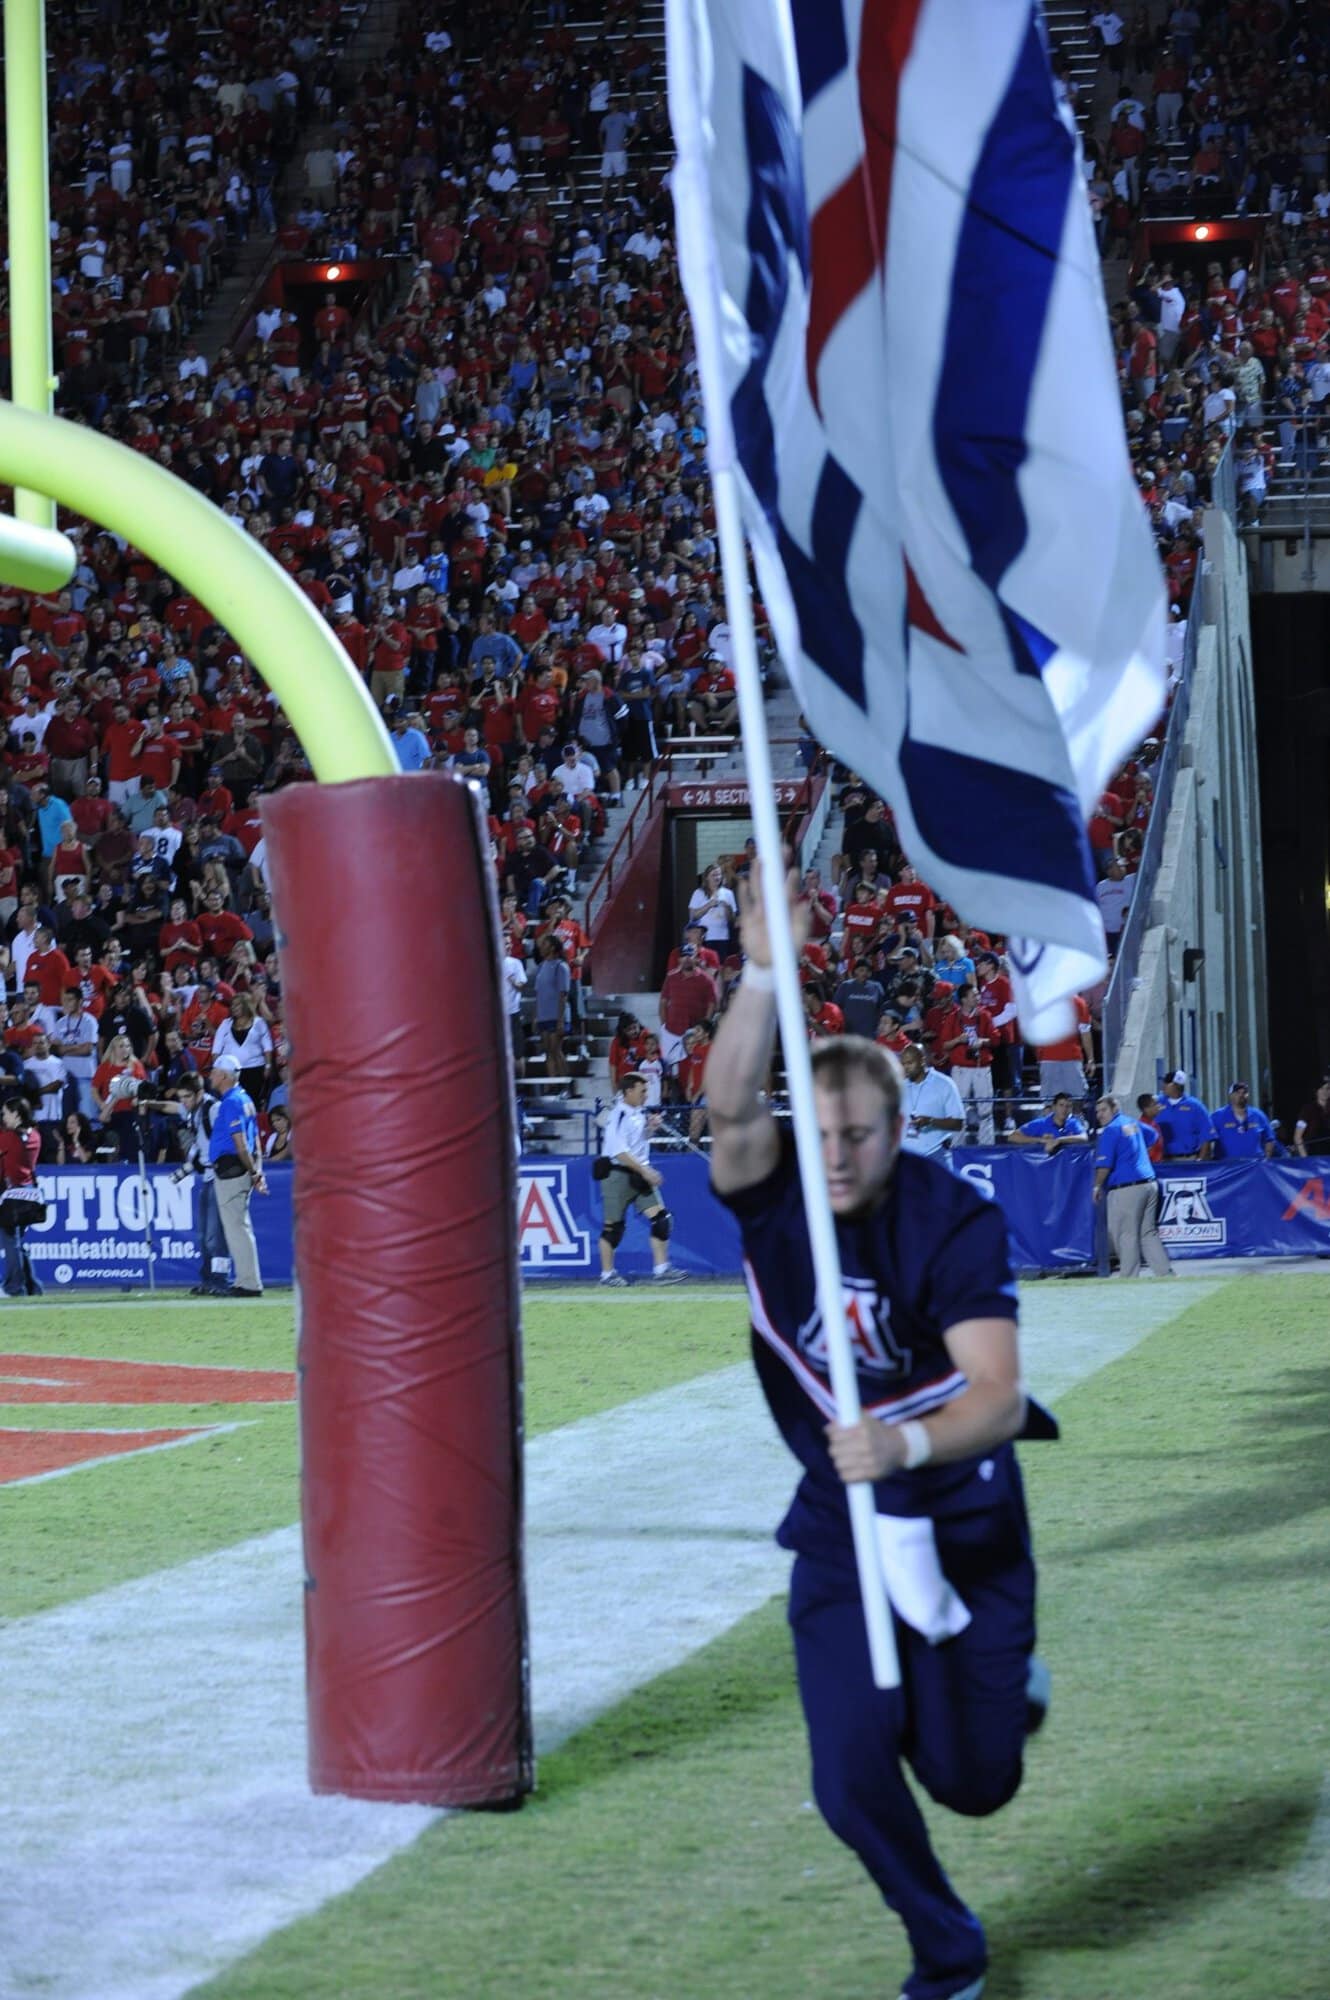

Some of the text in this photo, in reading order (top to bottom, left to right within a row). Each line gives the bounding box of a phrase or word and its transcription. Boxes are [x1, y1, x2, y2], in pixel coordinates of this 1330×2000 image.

[696, 789, 711, 805] 24
[715, 788, 750, 804] SECTI
[157, 838, 168, 855] 8
[517, 1164, 591, 1266] A
[23, 1237, 200, 1262] munications, Inc.
[76, 1268, 144, 1278] MOTOROLA
